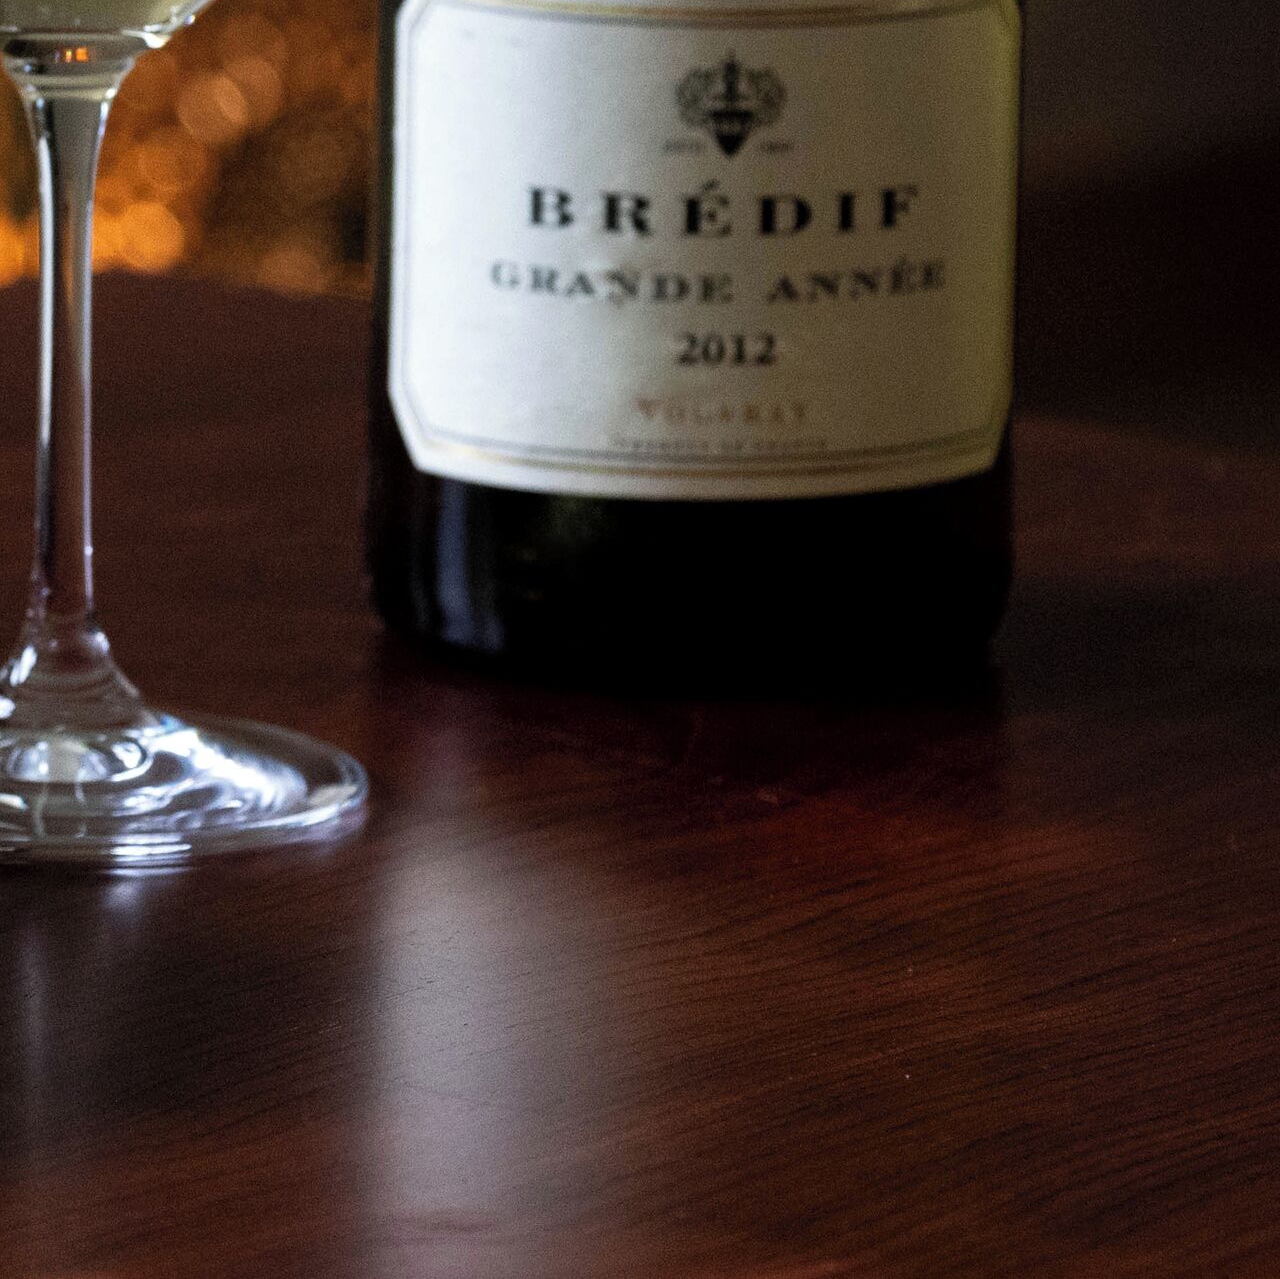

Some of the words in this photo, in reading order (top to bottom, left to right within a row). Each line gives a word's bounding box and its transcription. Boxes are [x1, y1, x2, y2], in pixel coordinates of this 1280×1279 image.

[526, 178, 920, 237] BRÉDIF
[490, 258, 736, 308] GRANDE
[767, 254, 948, 305] ANNÉE
[675, 331, 778, 367] 2012
